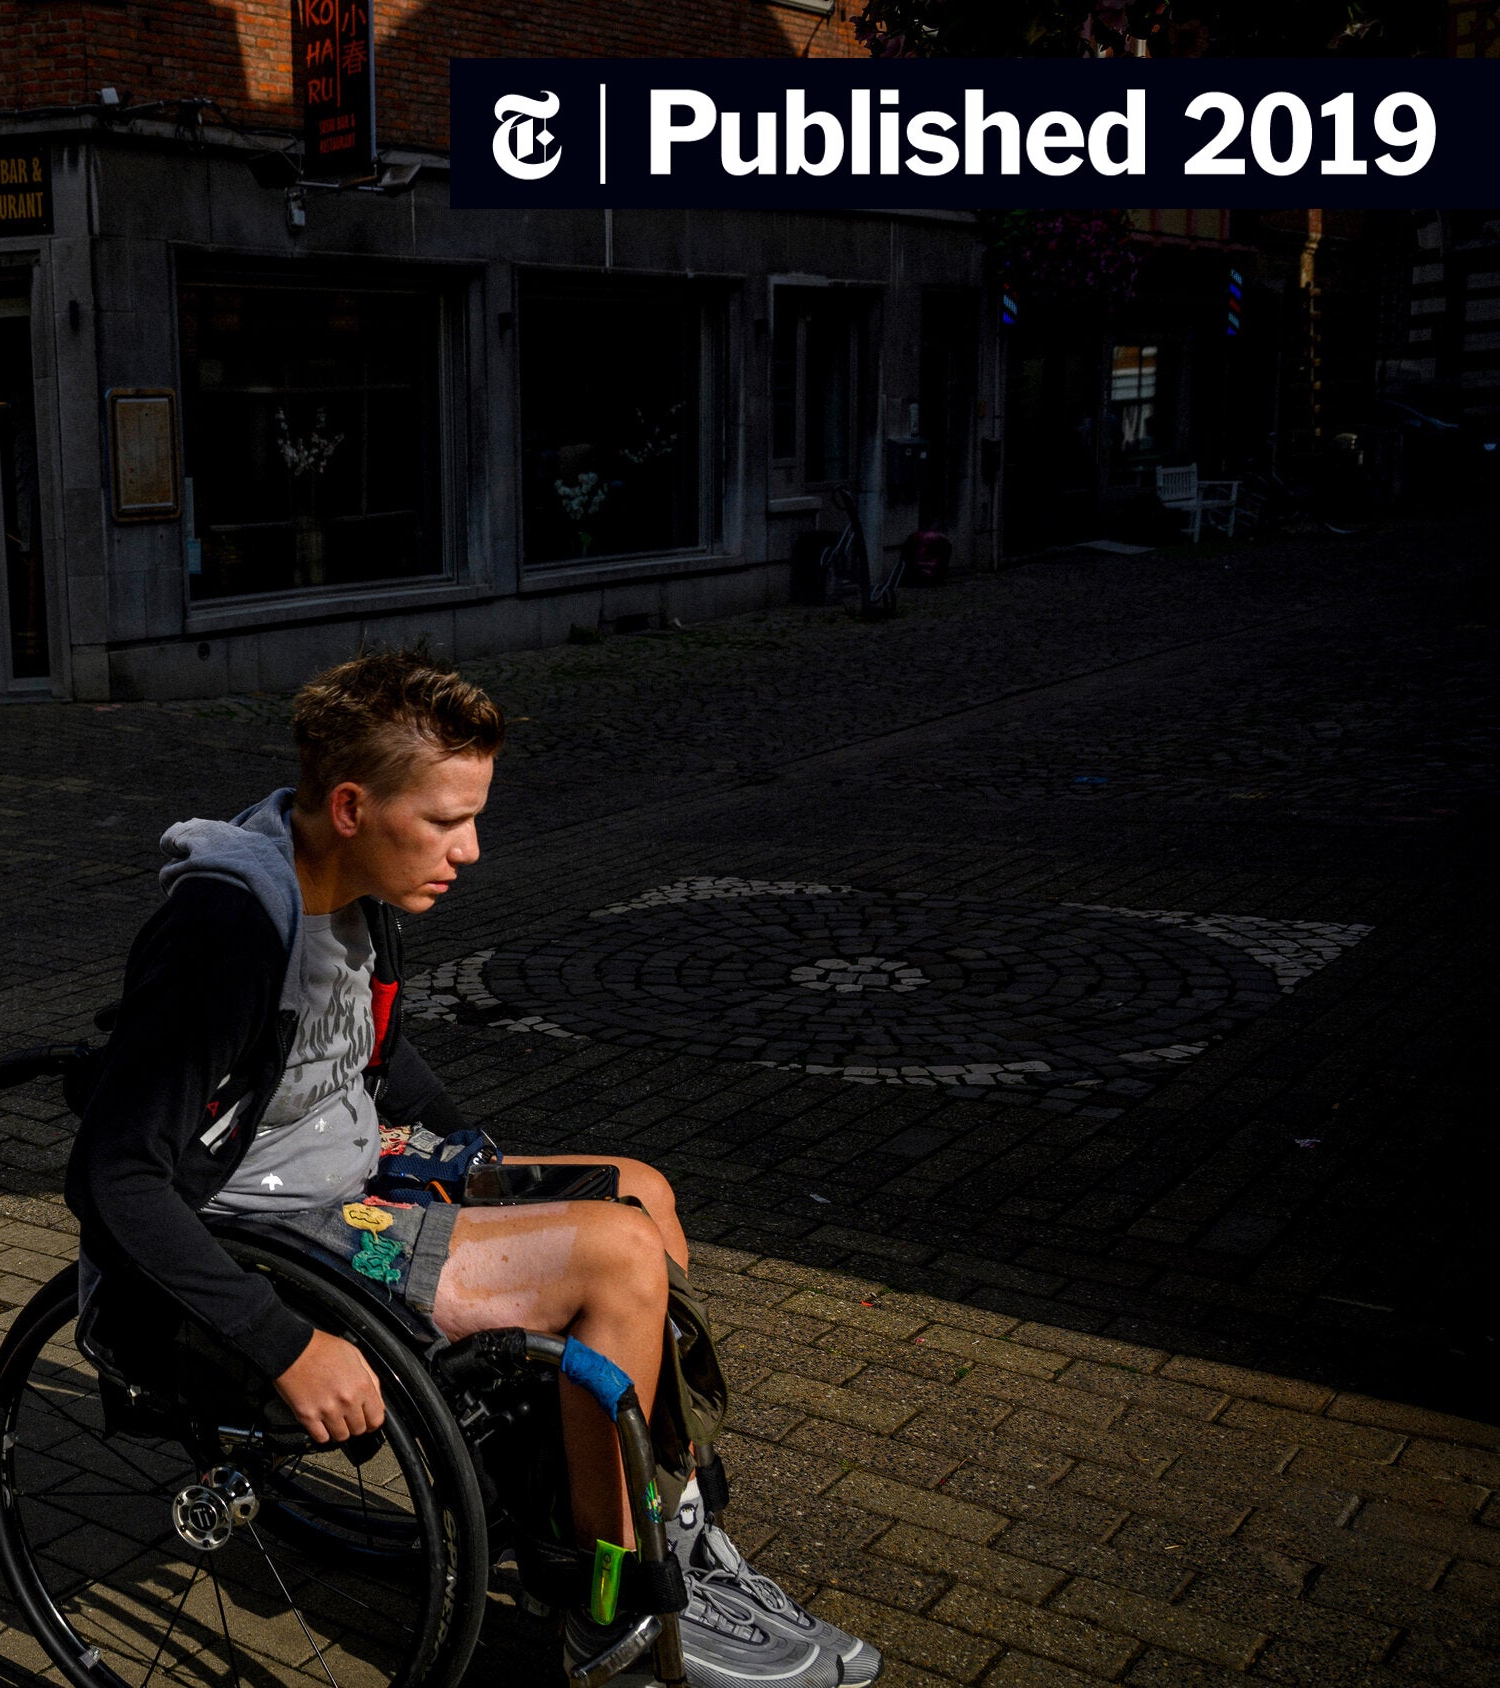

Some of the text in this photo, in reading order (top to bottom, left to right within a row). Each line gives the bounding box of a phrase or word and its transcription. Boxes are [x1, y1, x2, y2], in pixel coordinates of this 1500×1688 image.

[305, 0, 334, 29] KO
[306, 38, 334, 68] HA
[341, 3, 368, 75] 小春
[308, 76, 334, 105] RU
[1, 156, 29, 186] BAR
[31, 155, 44, 183] &
[193, 1507, 211, 1528] Ti
